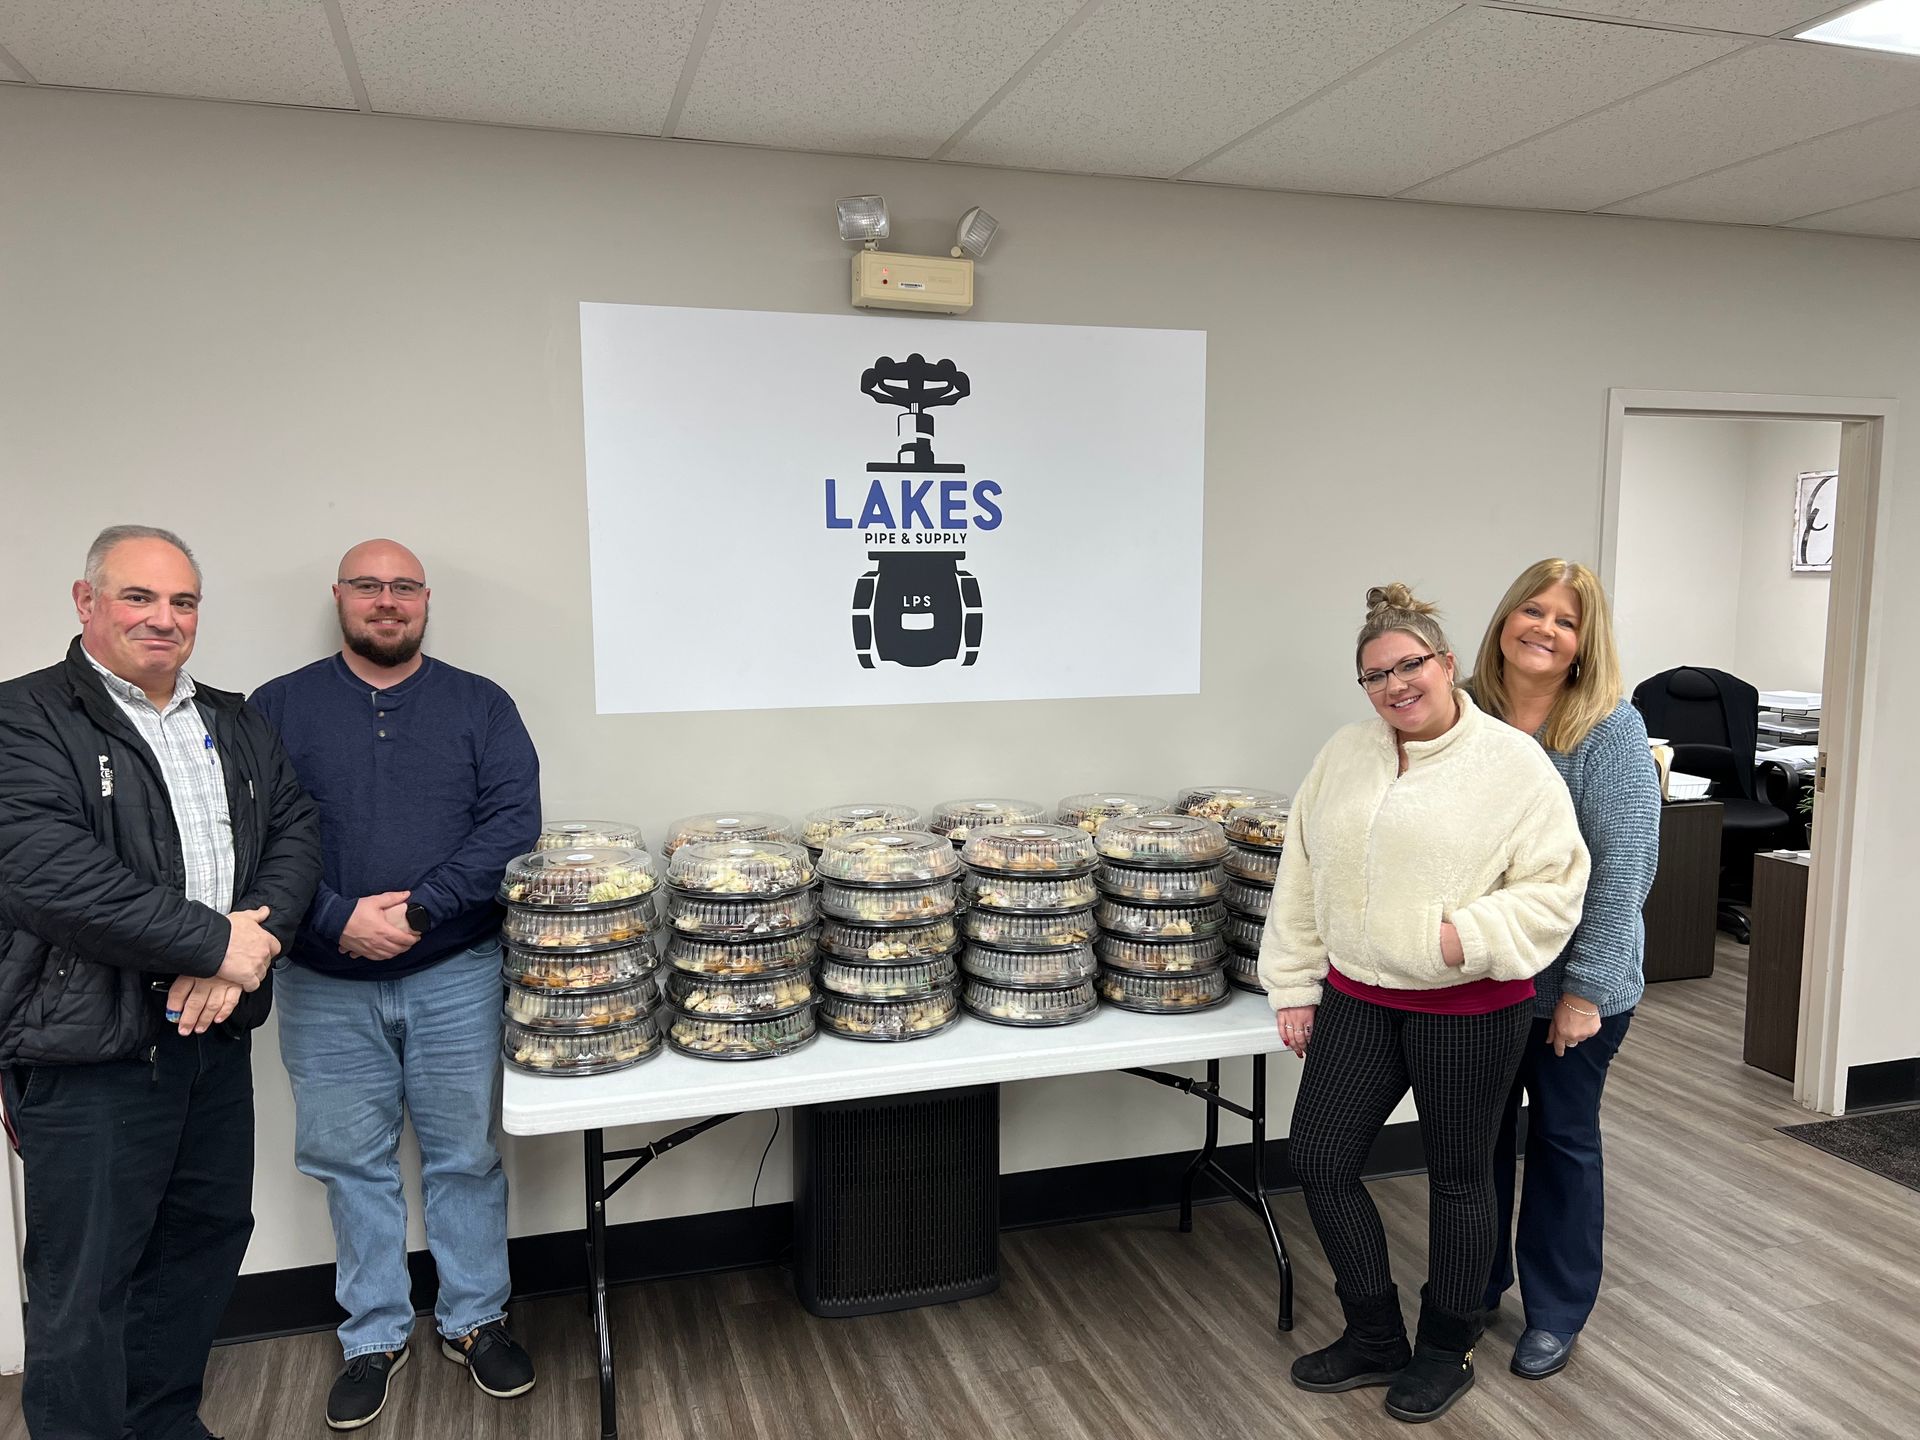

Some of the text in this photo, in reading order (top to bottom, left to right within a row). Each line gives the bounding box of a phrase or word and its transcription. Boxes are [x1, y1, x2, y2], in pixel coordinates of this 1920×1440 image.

[825, 478, 1003, 531] LAKES
[864, 532, 968, 545] PIPE & SUPPLY
[903, 595, 932, 608] LPS
